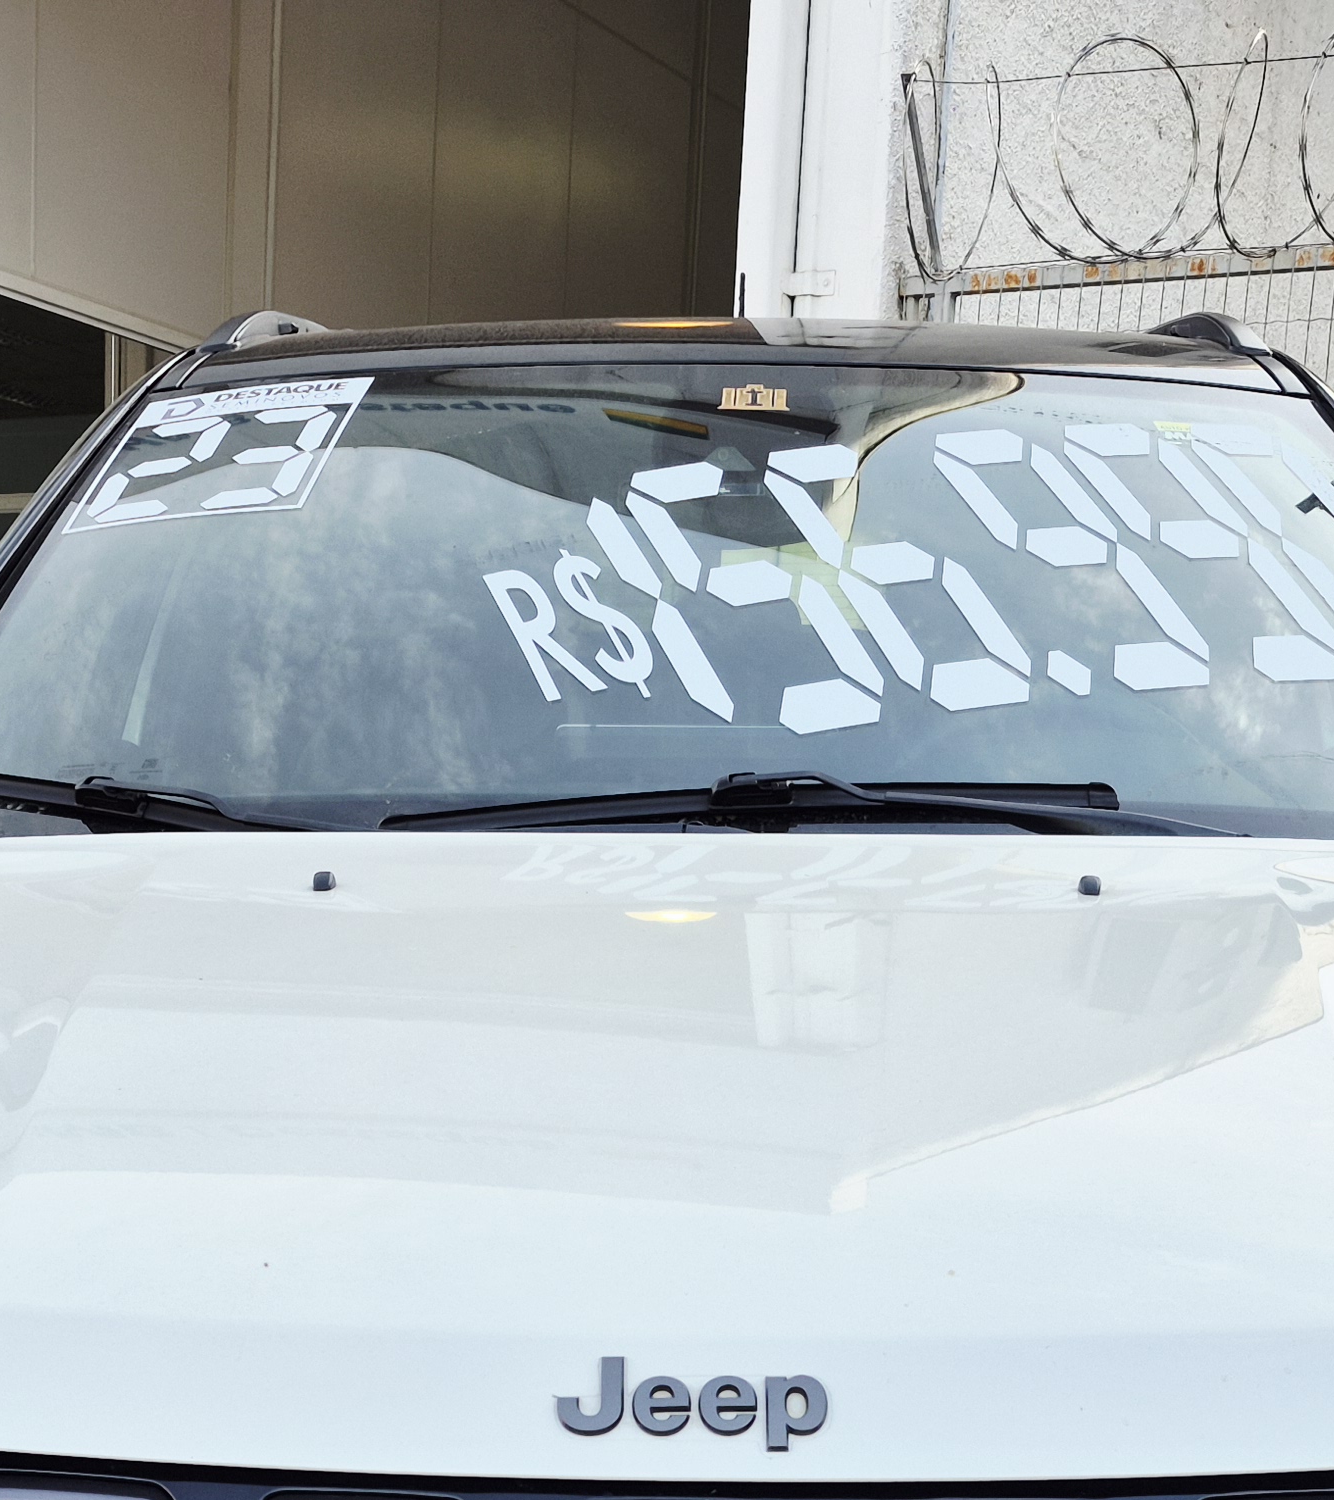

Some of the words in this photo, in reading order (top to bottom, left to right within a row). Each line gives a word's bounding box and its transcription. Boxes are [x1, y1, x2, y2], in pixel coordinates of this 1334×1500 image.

[214, 381, 349, 402] DESTAQUE
[86, 405, 337, 524] 23
[556, 1356, 828, 1452] Jeep
